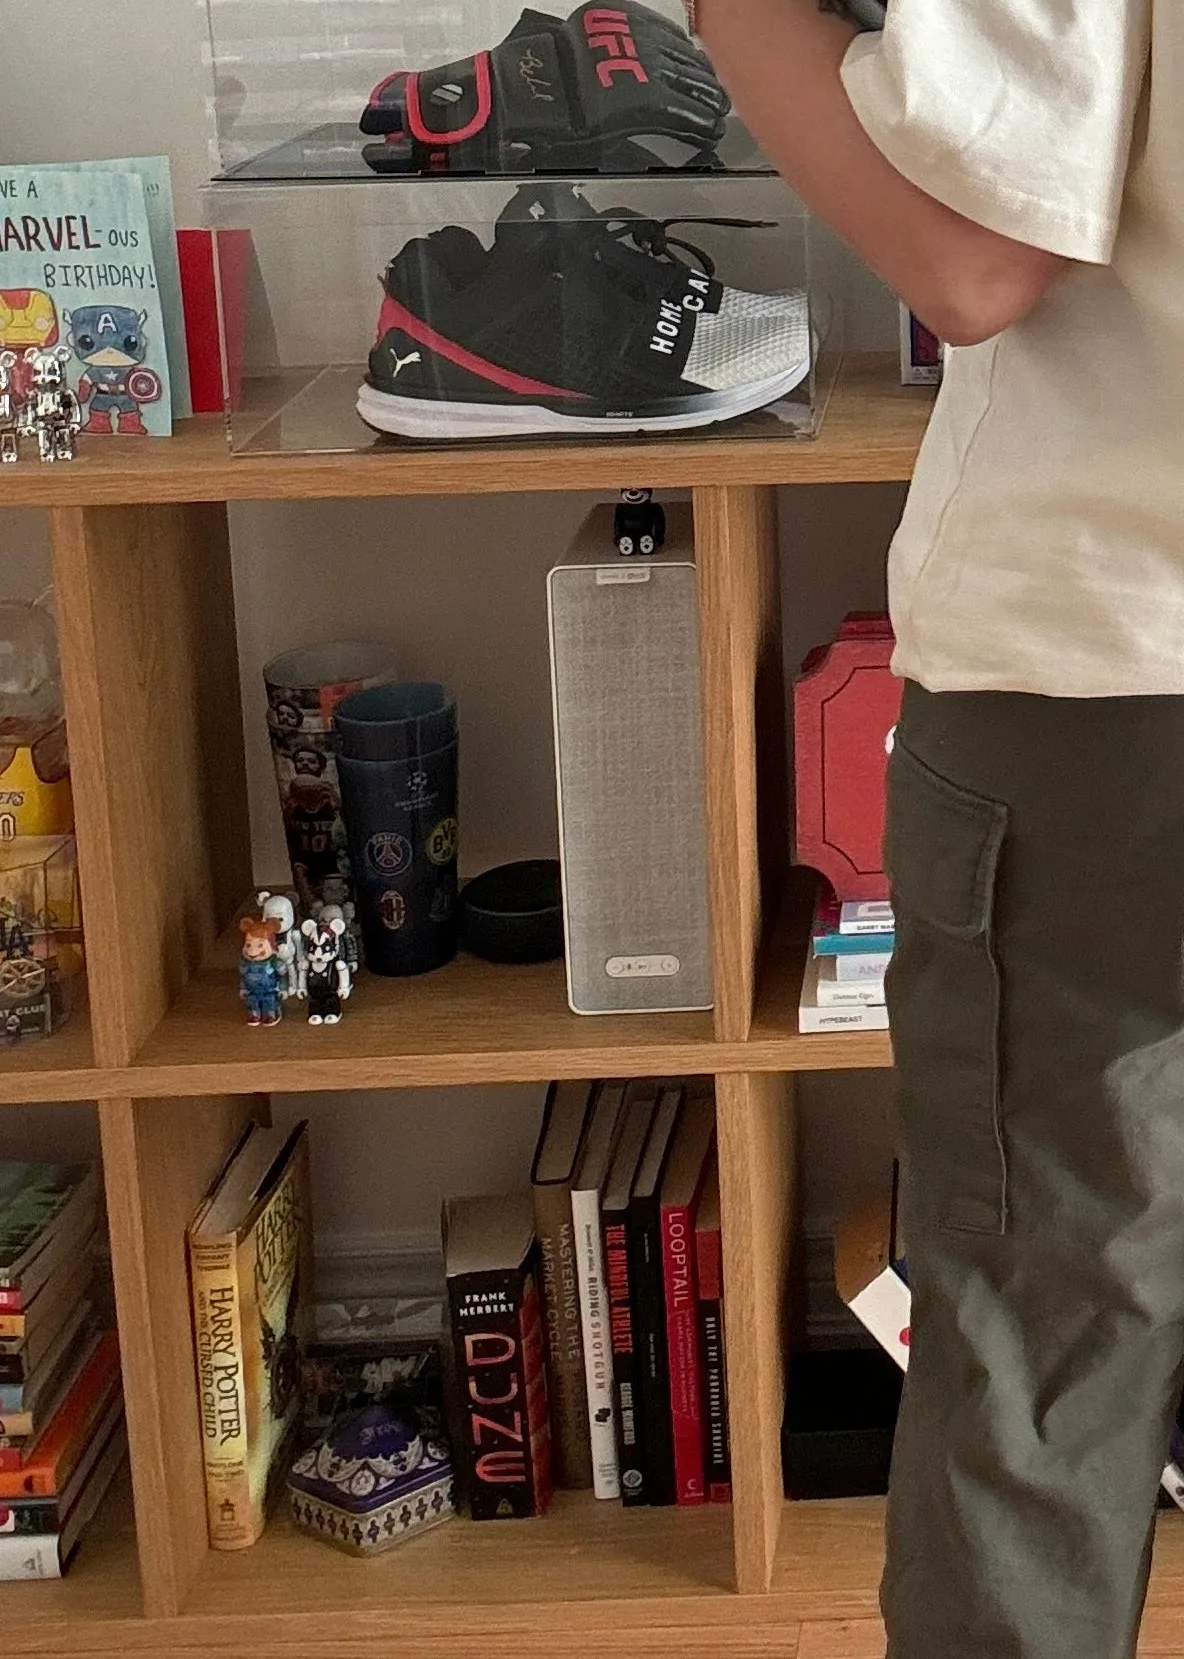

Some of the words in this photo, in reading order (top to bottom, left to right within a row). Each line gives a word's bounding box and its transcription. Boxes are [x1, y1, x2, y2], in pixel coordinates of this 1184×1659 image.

[583, 7, 650, 89] UFC
[27, 180, 39, 199] A
[0, 215, 103, 252] ARVEL-
[108, 228, 139, 248] OUS
[43, 263, 156, 290] BIRTHDAY!
[650, 298, 682, 354] HOME
[605, 1223, 626, 1246] THE
[539, 1237, 556, 1303] MARKET
[558, 1222, 579, 1320] MASTERING
[668, 1212, 690, 1308] LOOPTAIL
[209, 1285, 236, 1355] HARRY
[459, 1303, 515, 1317] HERBERT
[464, 1291, 507, 1304] FRANK
[588, 1275, 602, 1320] RIDING
[566, 1324, 581, 1360] THE
[613, 1306, 633, 1354] ATHLETE
[198, 1331, 213, 1393] CURSED
[592, 1320, 606, 1392] SHOTGUN
[202, 1394, 218, 1438] CHILD
[214, 1352, 242, 1446] POTTER
